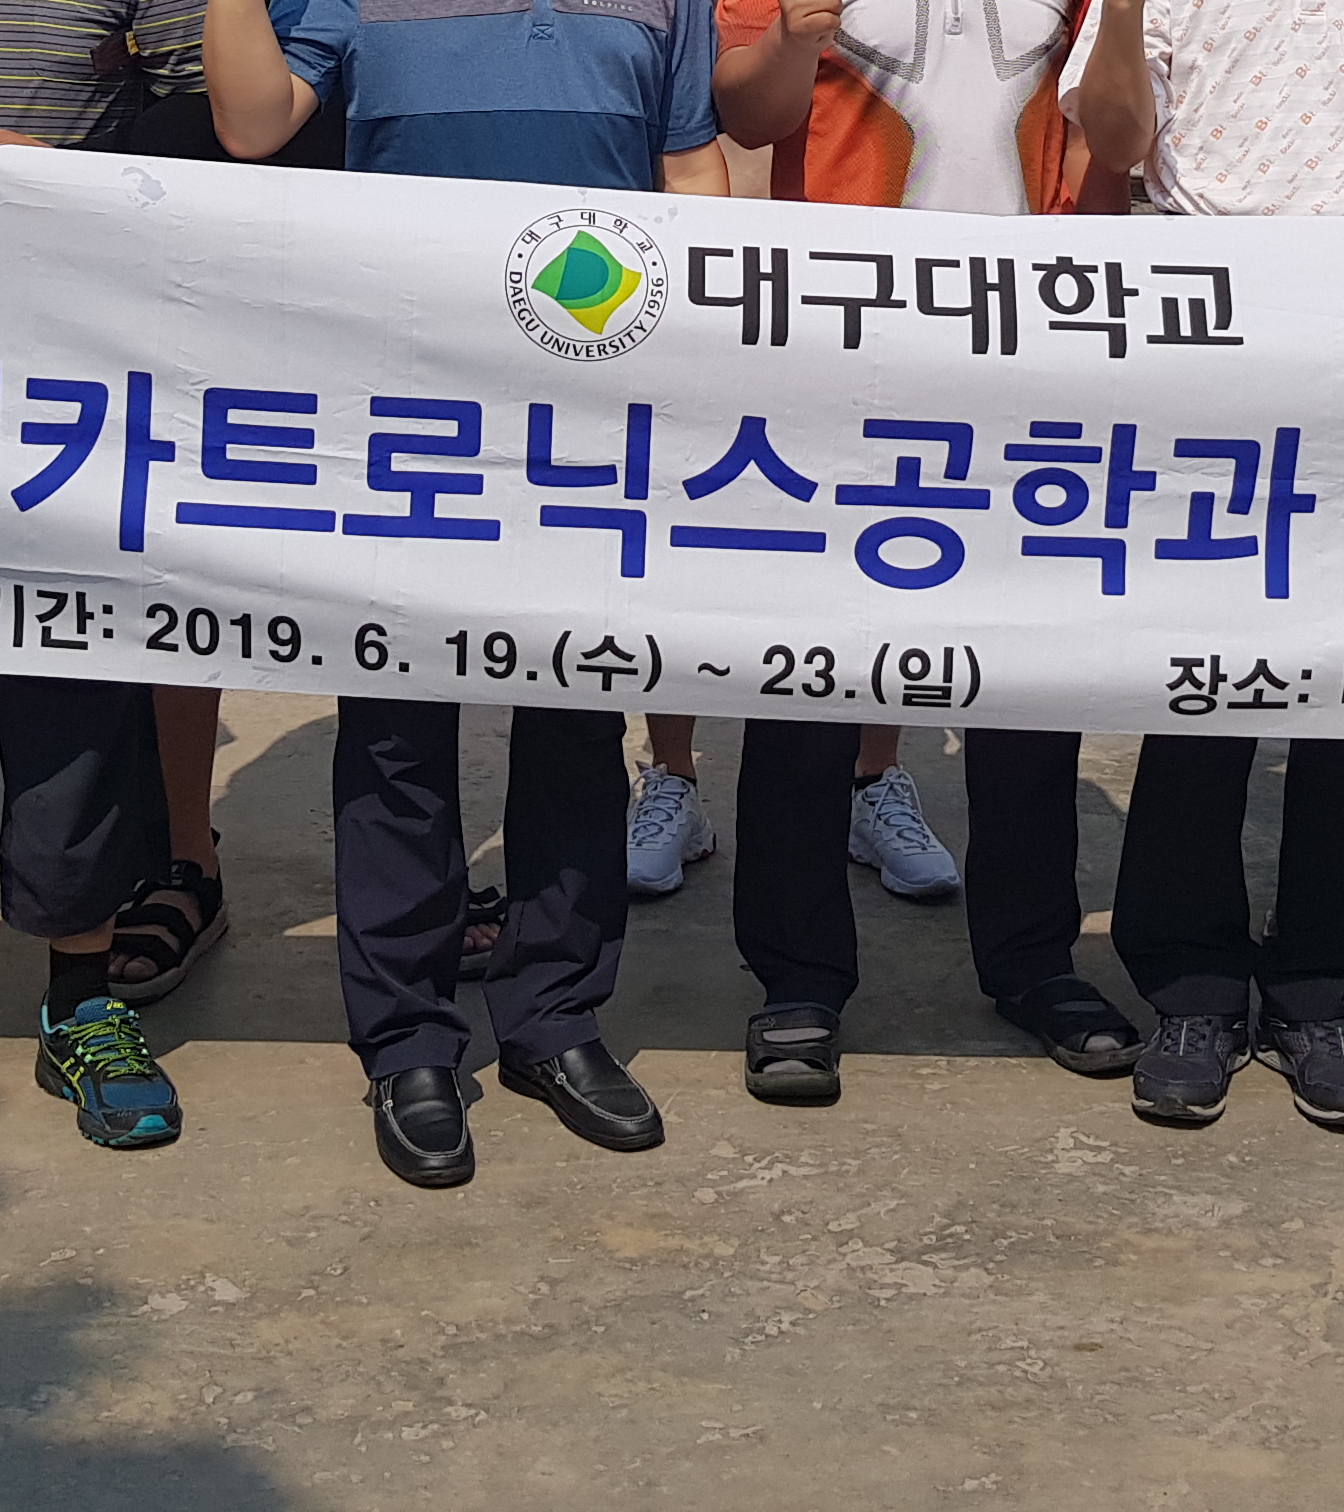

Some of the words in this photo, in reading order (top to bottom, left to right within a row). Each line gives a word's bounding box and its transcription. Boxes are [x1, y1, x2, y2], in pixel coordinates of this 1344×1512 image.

[509, 271, 541, 332] DAEGU
[540, 319, 648, 358] UNIVERSITY
[644, 277, 665, 319] 1956
[687, 246, 1244, 359] 대구대학교
[145, 602, 323, 666] 2019.
[354, 622, 410, 673] 6.
[1165, 653, 1314, 717] 장소:
